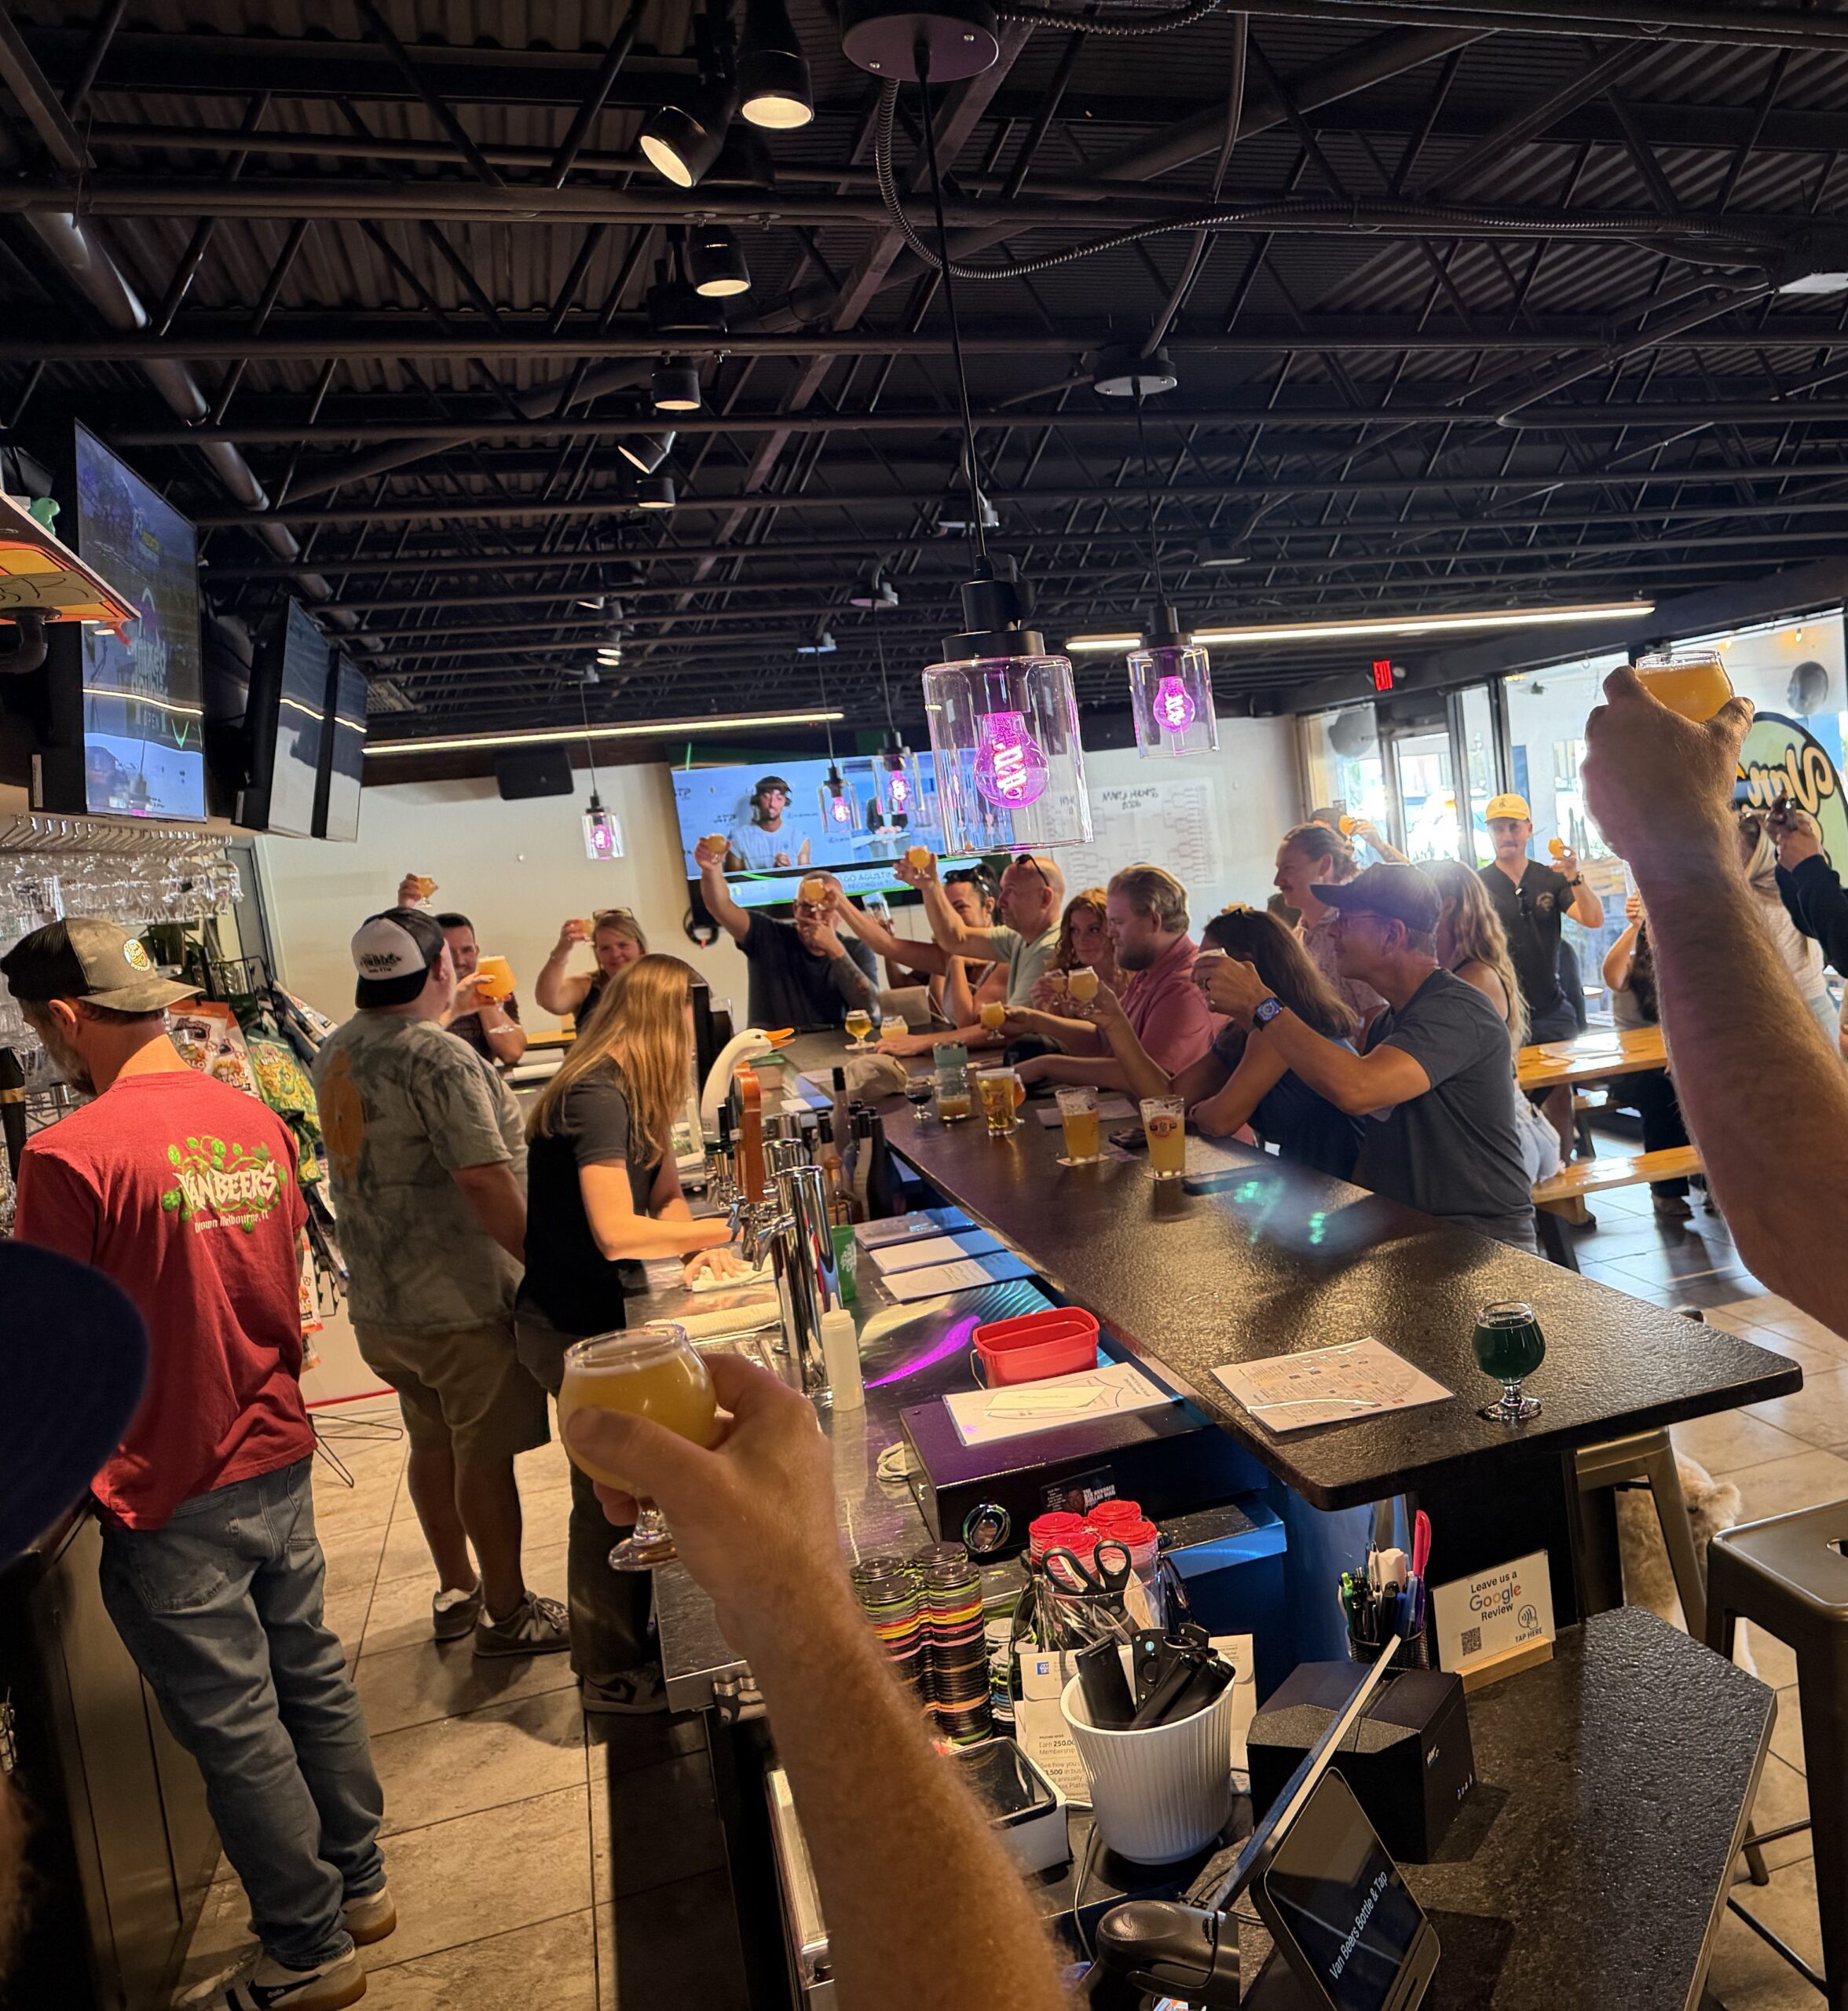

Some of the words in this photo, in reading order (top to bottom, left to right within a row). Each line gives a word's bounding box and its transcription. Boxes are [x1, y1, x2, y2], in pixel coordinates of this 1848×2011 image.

[1471, 1577, 1498, 1593] Leave
[1499, 1574, 1510, 1583] us
[1469, 1582, 1521, 1611] Google
[1481, 1603, 1513, 1621] Review
[1515, 1633, 1526, 1643] TAP
[1528, 1627, 1542, 1639] HERE
[1374, 1871, 1388, 1892] Tap
[1370, 1888, 1379, 1902] &
[1355, 1898, 1374, 1931] Bottle
[1340, 1926, 1359, 1960] Beers
[1330, 1955, 1345, 1980] Van
